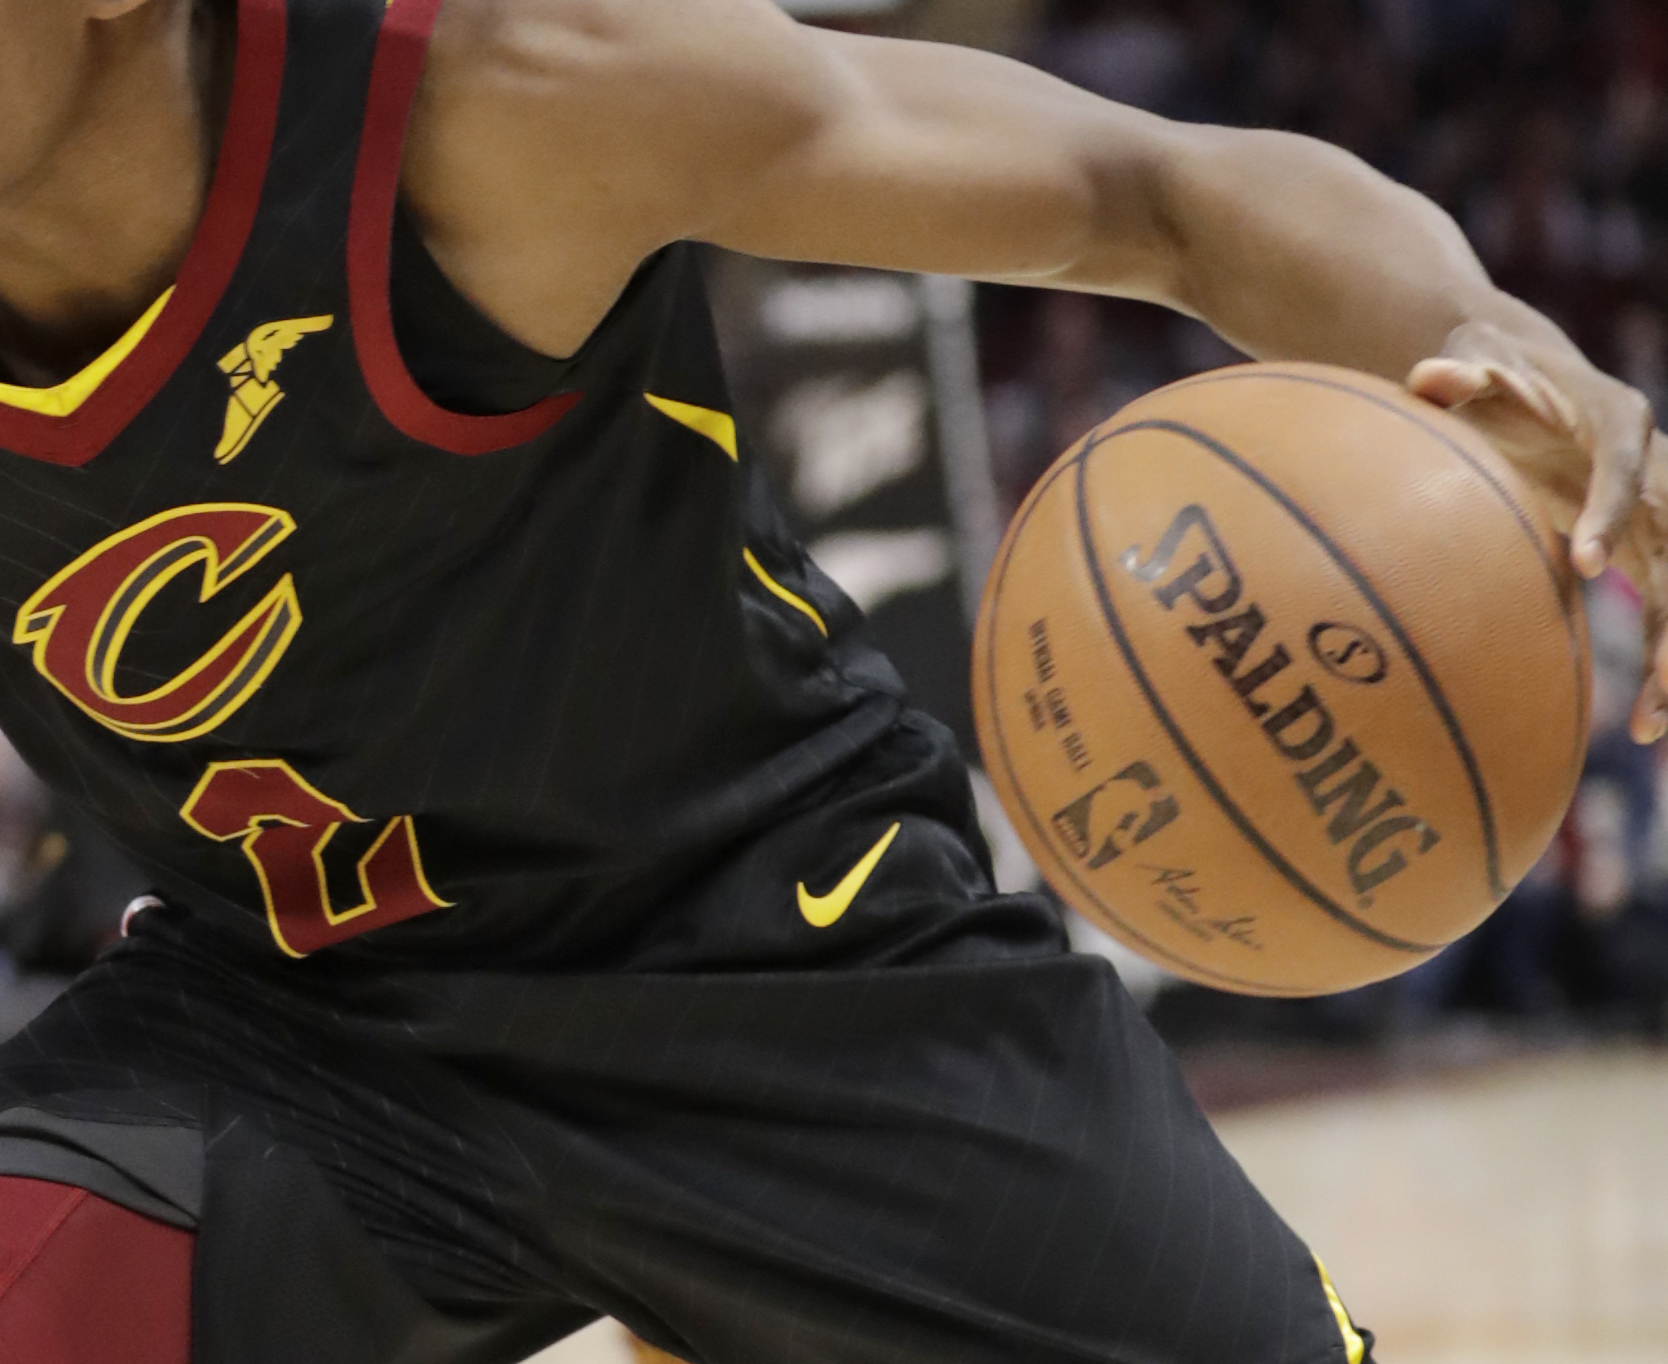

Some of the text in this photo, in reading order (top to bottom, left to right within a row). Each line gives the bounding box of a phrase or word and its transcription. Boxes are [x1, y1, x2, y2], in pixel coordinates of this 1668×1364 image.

[13, 502, 302, 742] C
[1119, 503, 1440, 895] SPALDING
[180, 758, 457, 958] 2
